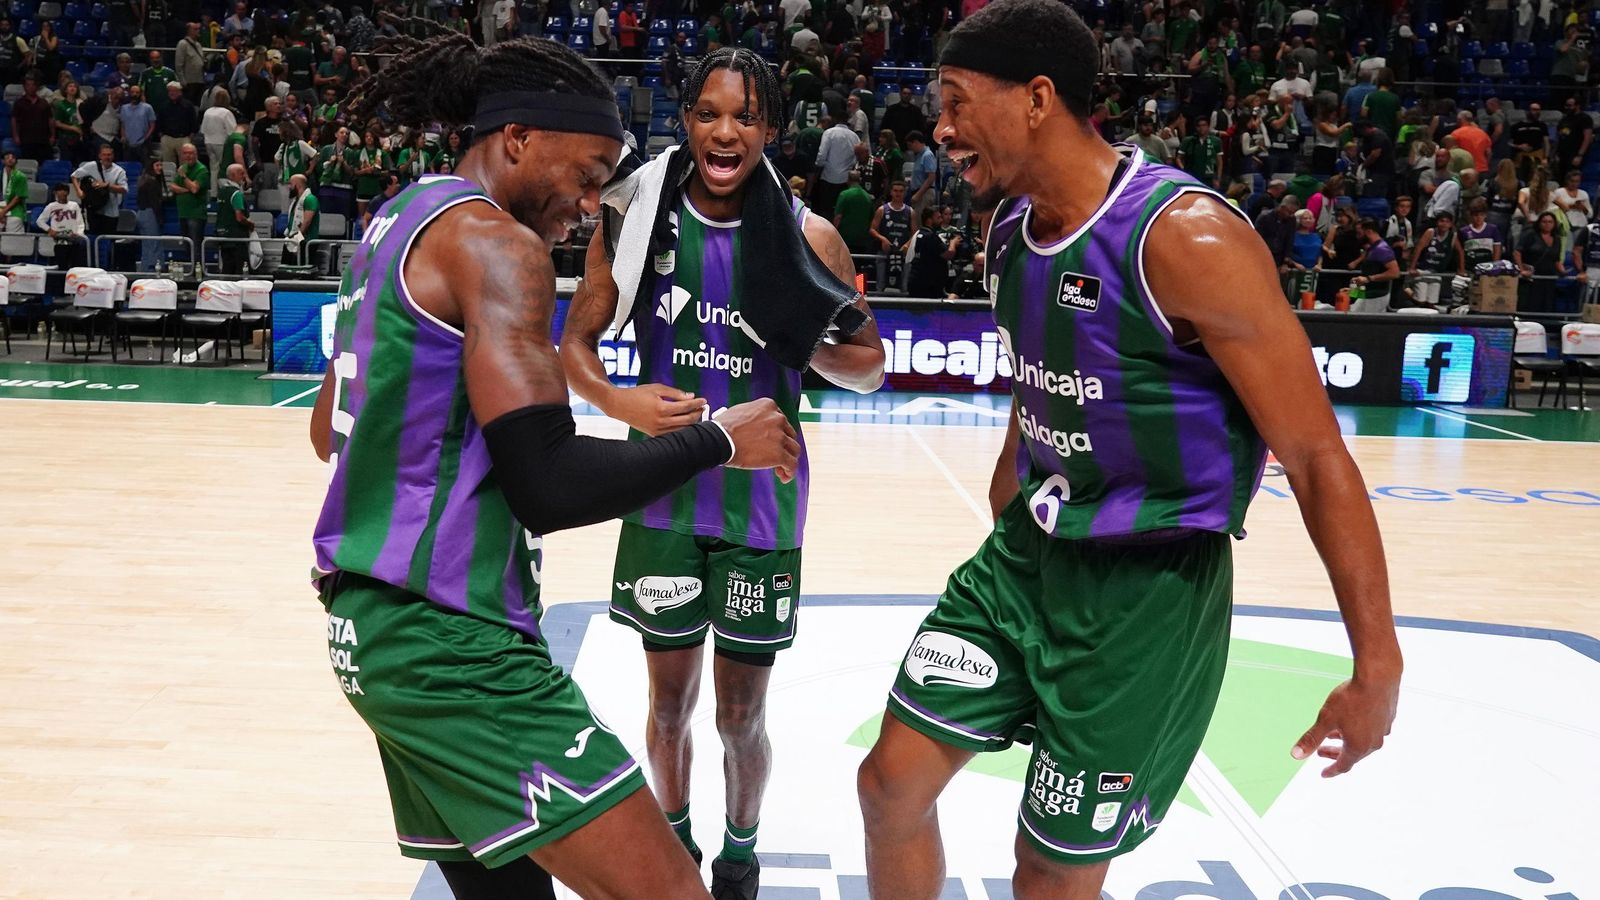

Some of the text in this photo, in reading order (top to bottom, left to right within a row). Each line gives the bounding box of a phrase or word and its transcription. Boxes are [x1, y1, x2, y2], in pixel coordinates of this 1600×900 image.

[806, 109, 818, 127] 5
[1063, 283, 1081, 295] liga
[1062, 293, 1097, 308] endesa
[1011, 351, 1104, 406] Unicaja
[1029, 473, 1071, 535] 6
[728, 570, 746, 580] sabor
[635, 577, 699, 600] famadesa
[776, 580, 790, 588] acb
[725, 587, 766, 617] laga
[1101, 781, 1124, 790] acb
